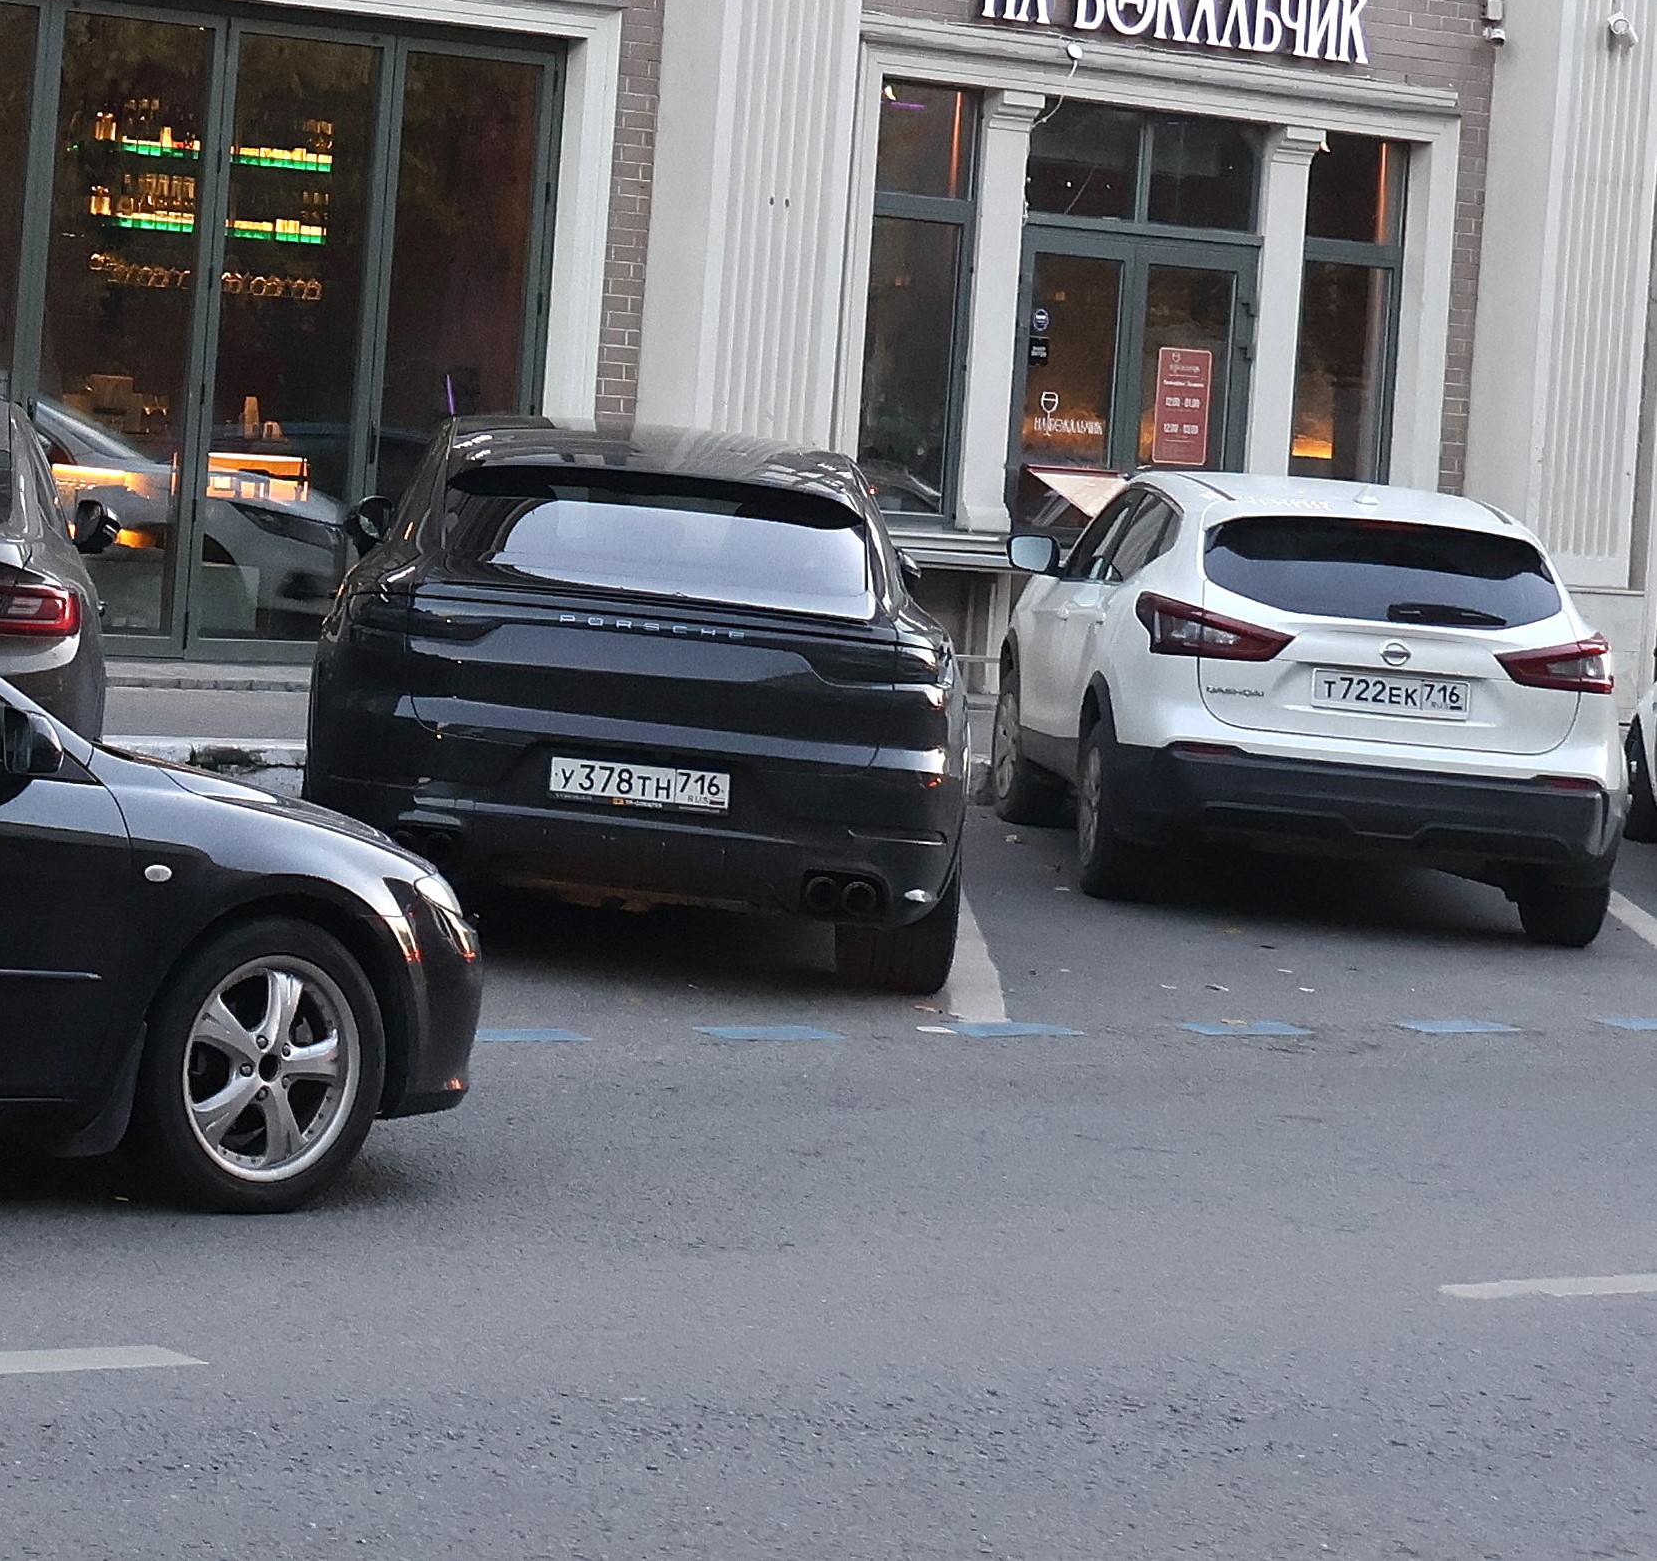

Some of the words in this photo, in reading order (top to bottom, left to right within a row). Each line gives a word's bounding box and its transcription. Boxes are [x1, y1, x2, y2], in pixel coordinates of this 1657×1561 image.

[559, 613, 745, 639] PORSCHE
[1423, 683, 1461, 705] 716
[678, 772, 720, 796] 716
